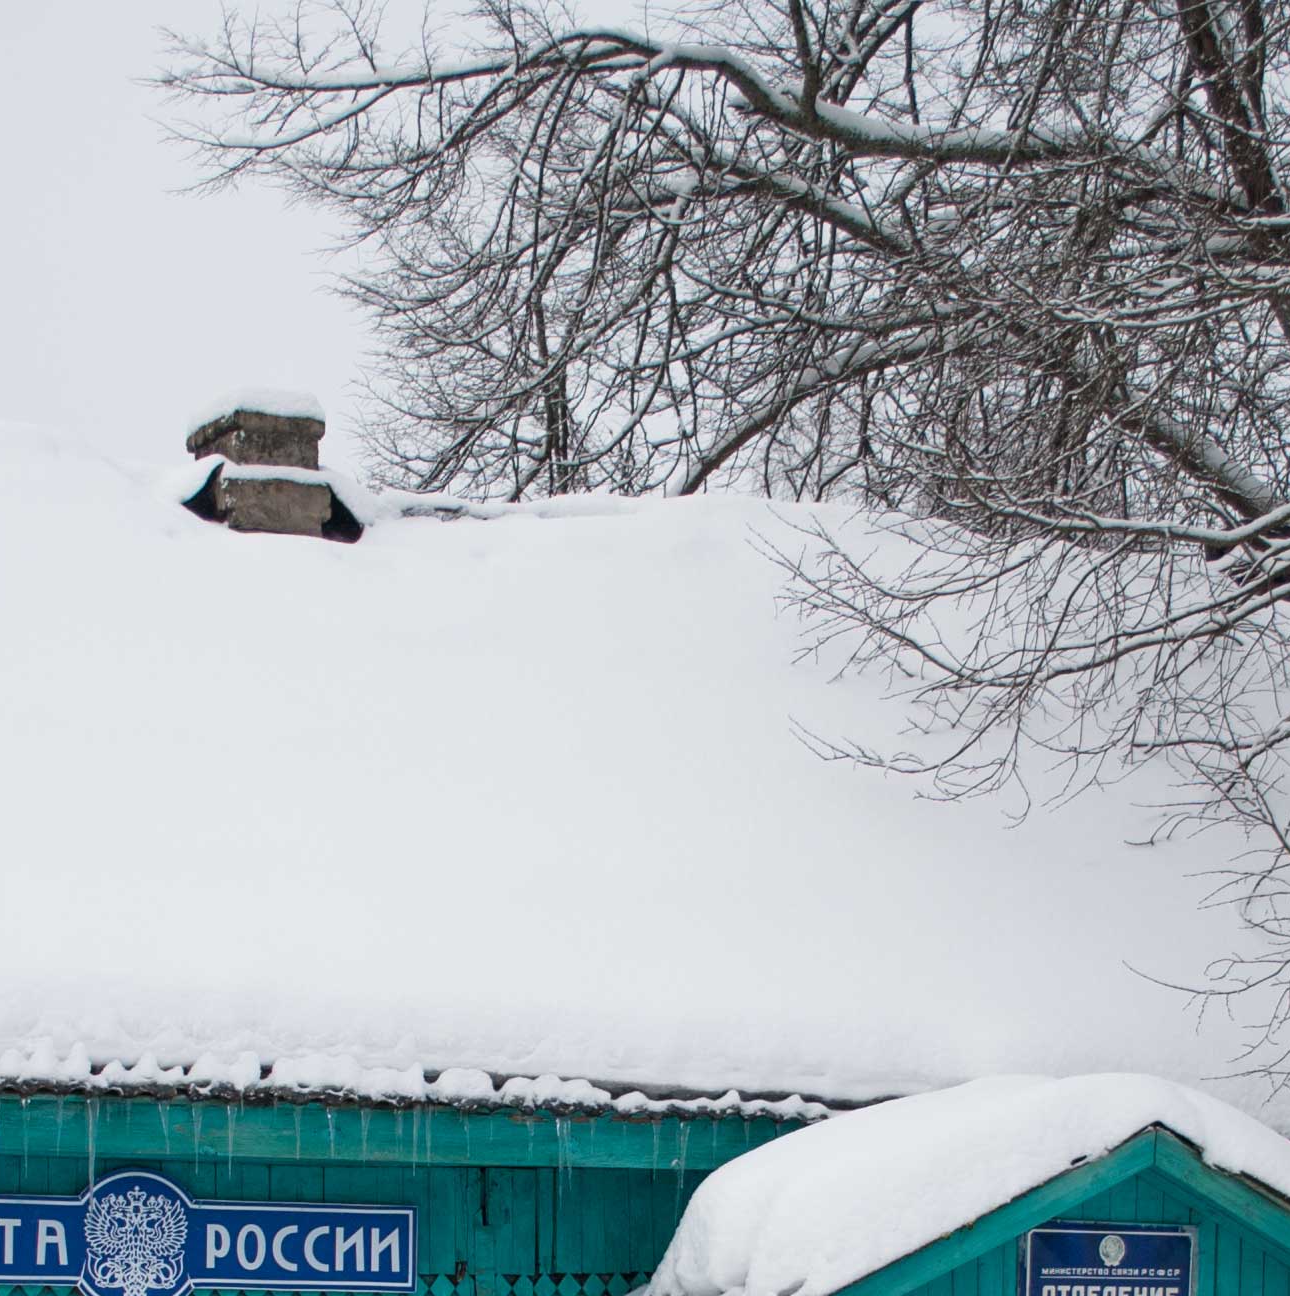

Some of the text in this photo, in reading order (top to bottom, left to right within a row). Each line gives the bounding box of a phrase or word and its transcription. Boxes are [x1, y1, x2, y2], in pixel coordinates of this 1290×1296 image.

[206, 1222, 402, 1274] РОССИИ
[1041, 1267, 1108, 1276] МИНИСТЕРСТВО
[1111, 1268, 1139, 1276] СВЯЗИ
